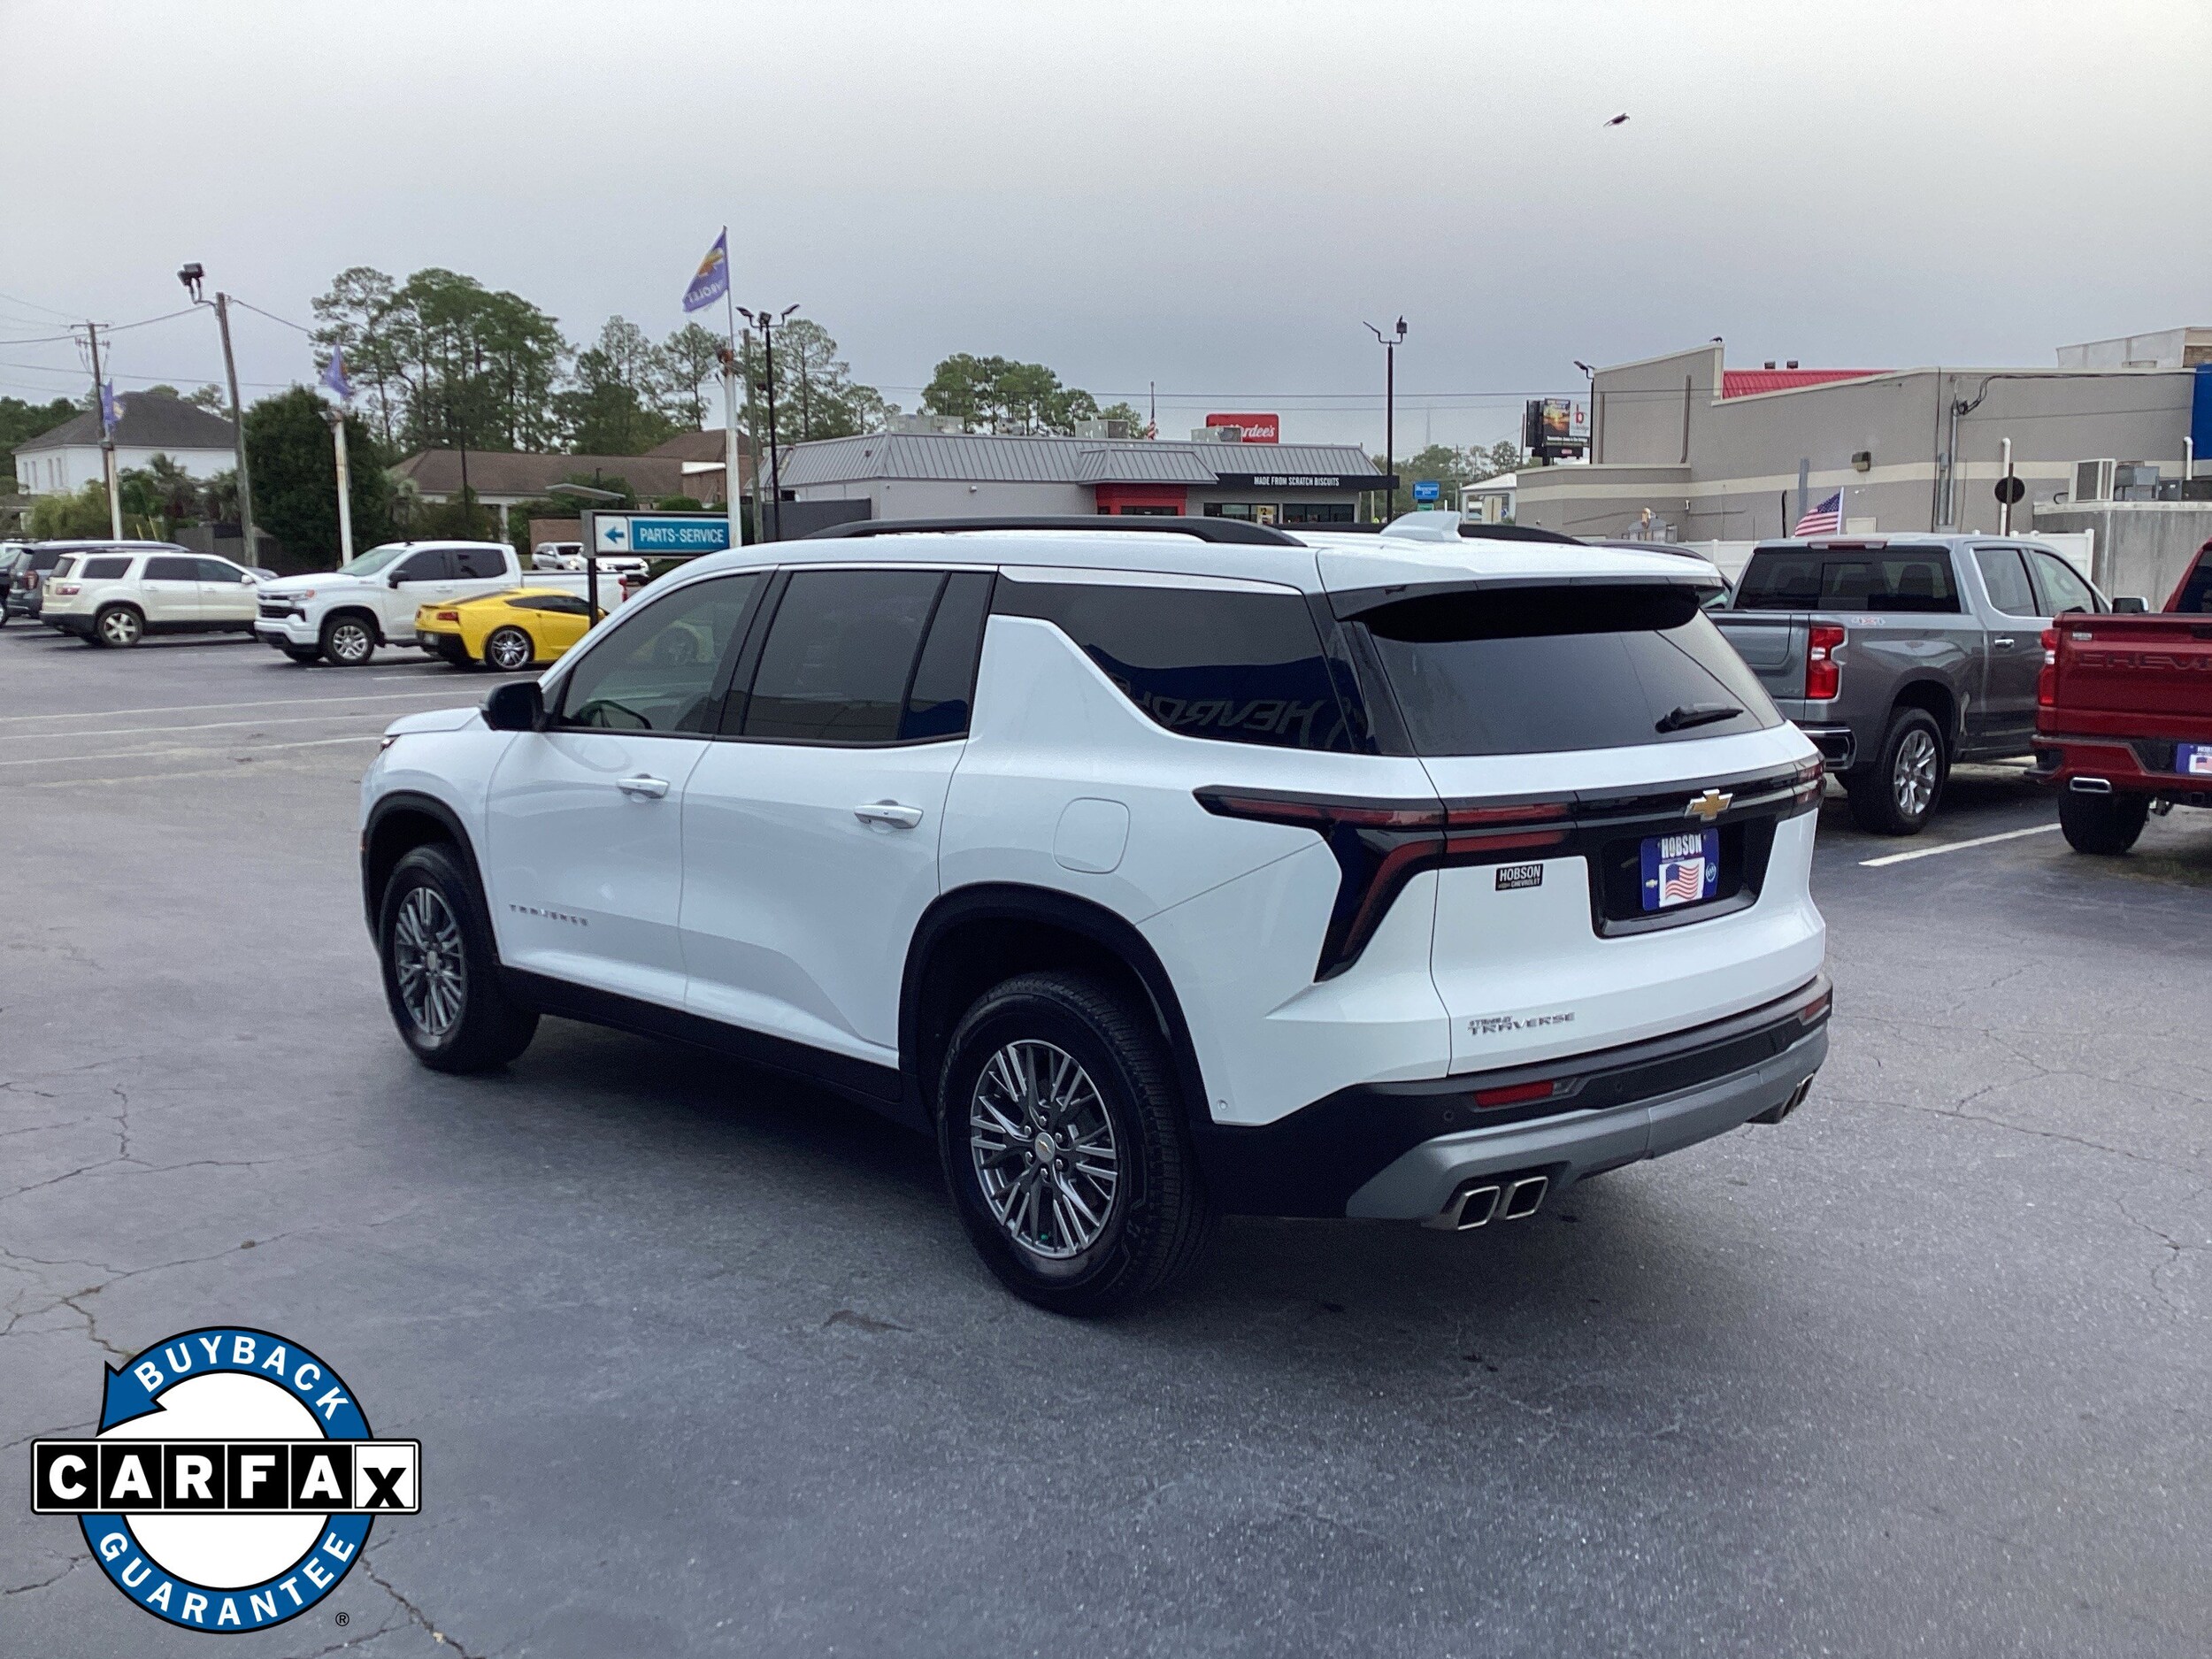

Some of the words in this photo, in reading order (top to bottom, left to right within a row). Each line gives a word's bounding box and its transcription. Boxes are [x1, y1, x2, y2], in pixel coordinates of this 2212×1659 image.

[1254, 476, 1271, 486] MADE
[1271, 476, 1287, 486] FROM
[1288, 477, 1314, 487] SCRATCH
[1314, 477, 1340, 487] BISCUITS
[1661, 833, 1702, 858] HOBSON
[1499, 864, 1541, 882] HOBSON
[1467, 1012, 1575, 1035] TRAVERSE
